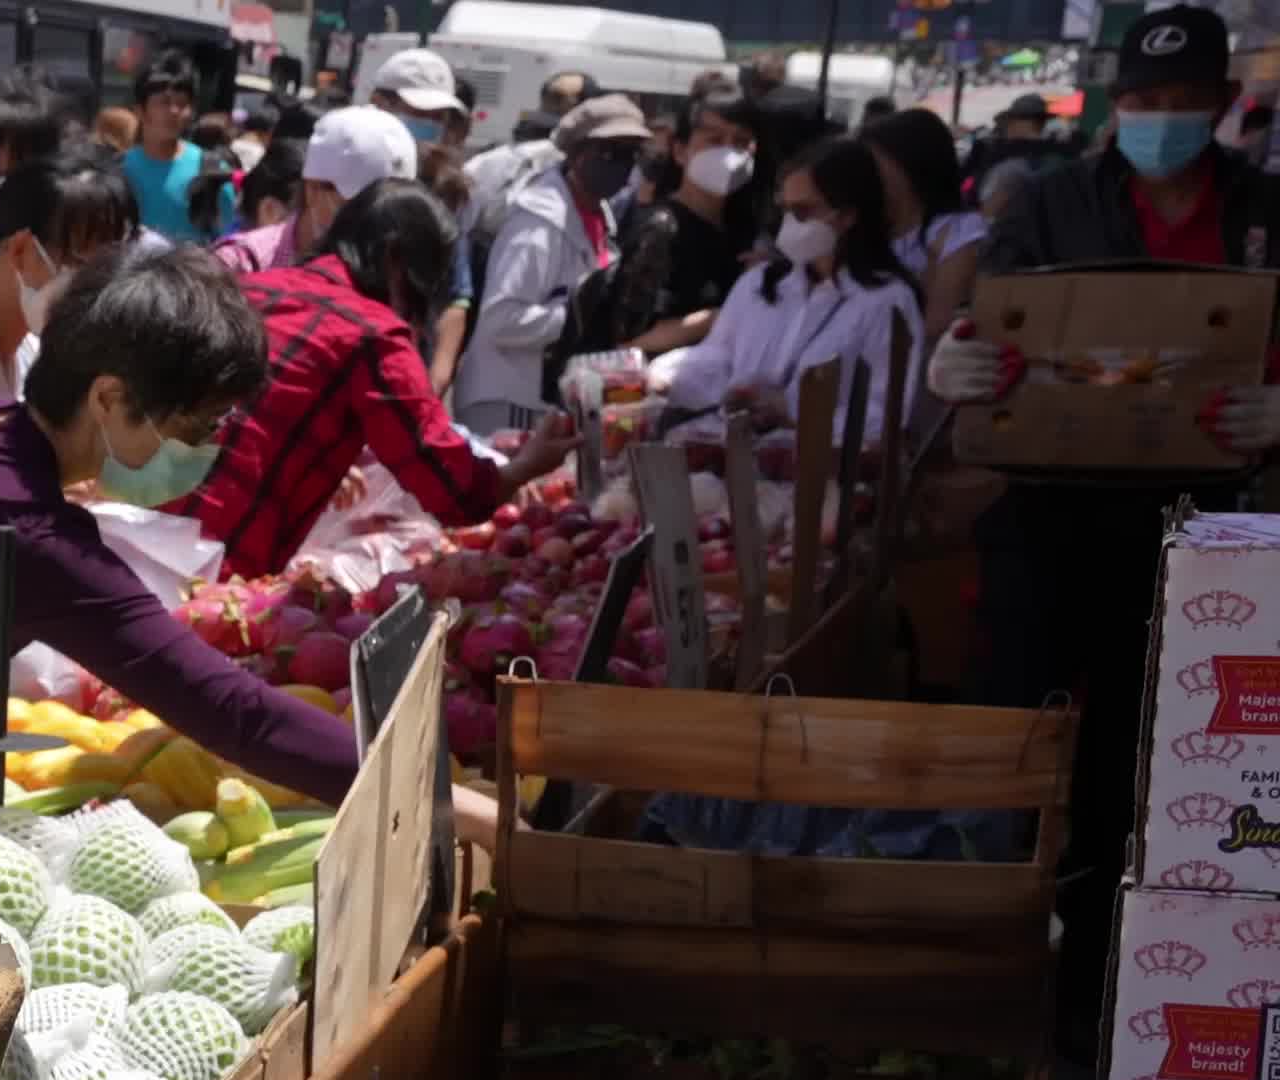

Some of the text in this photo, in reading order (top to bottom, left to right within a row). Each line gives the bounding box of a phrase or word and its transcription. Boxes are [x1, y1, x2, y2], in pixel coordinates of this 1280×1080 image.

[1251, 787, 1263, 798] &
[1188, 1041, 1251, 1060] Majesty
[1191, 1056, 1245, 1073] brand!
